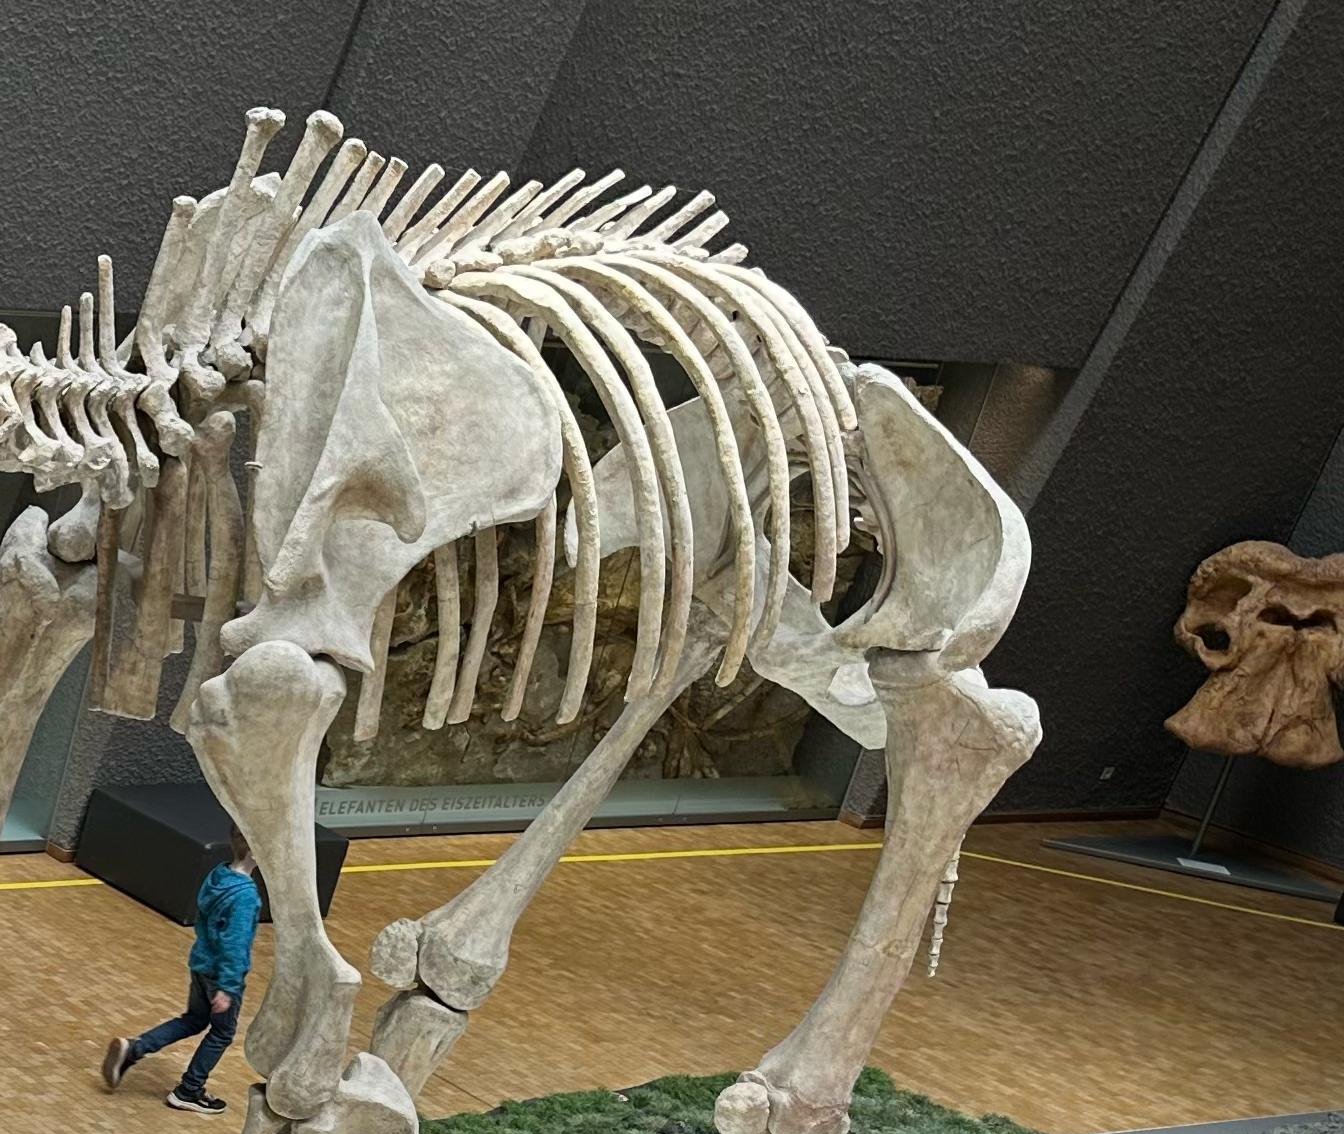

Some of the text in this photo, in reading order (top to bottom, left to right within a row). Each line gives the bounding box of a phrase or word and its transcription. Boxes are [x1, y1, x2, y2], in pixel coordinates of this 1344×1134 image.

[318, 794, 545, 815] ELEFANTEN DES EISZEITALTERS
